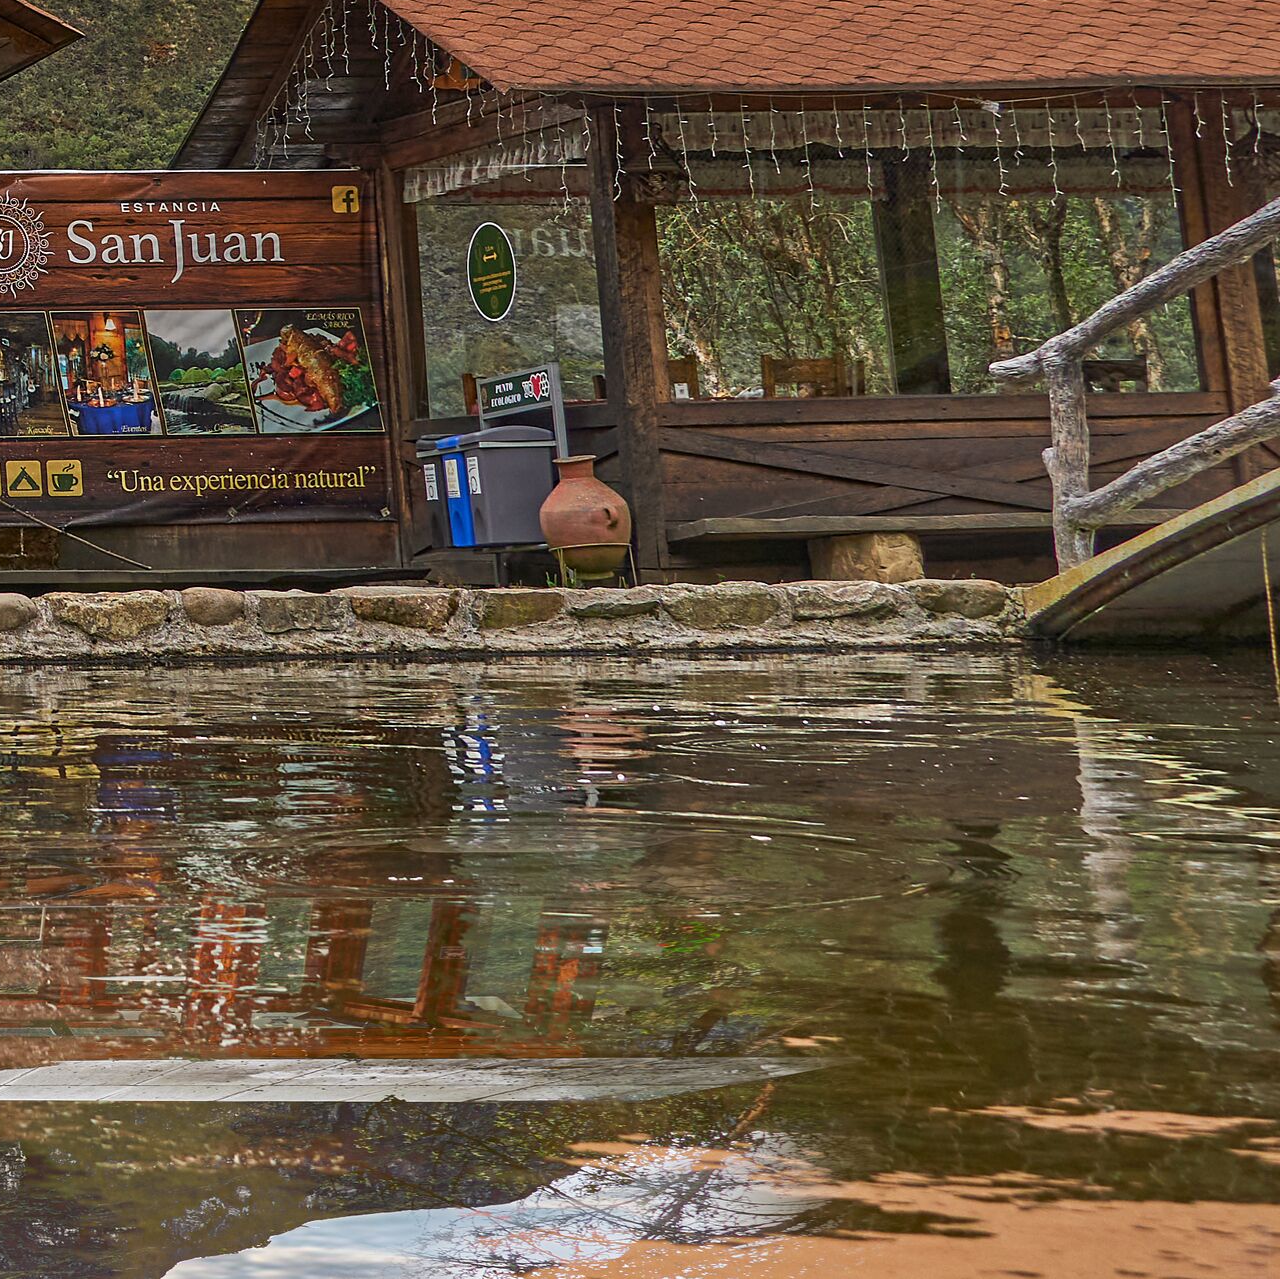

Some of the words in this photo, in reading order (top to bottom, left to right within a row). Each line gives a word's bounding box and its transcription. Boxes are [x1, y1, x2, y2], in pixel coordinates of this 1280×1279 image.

[120, 201, 221, 214] ESTANCIA
[337, 312, 355, 321] RICO
[495, 382, 514, 394] PUNTO
[490, 393, 522, 408] ECOLOGICO
[170, 468, 289, 497] experiencia
